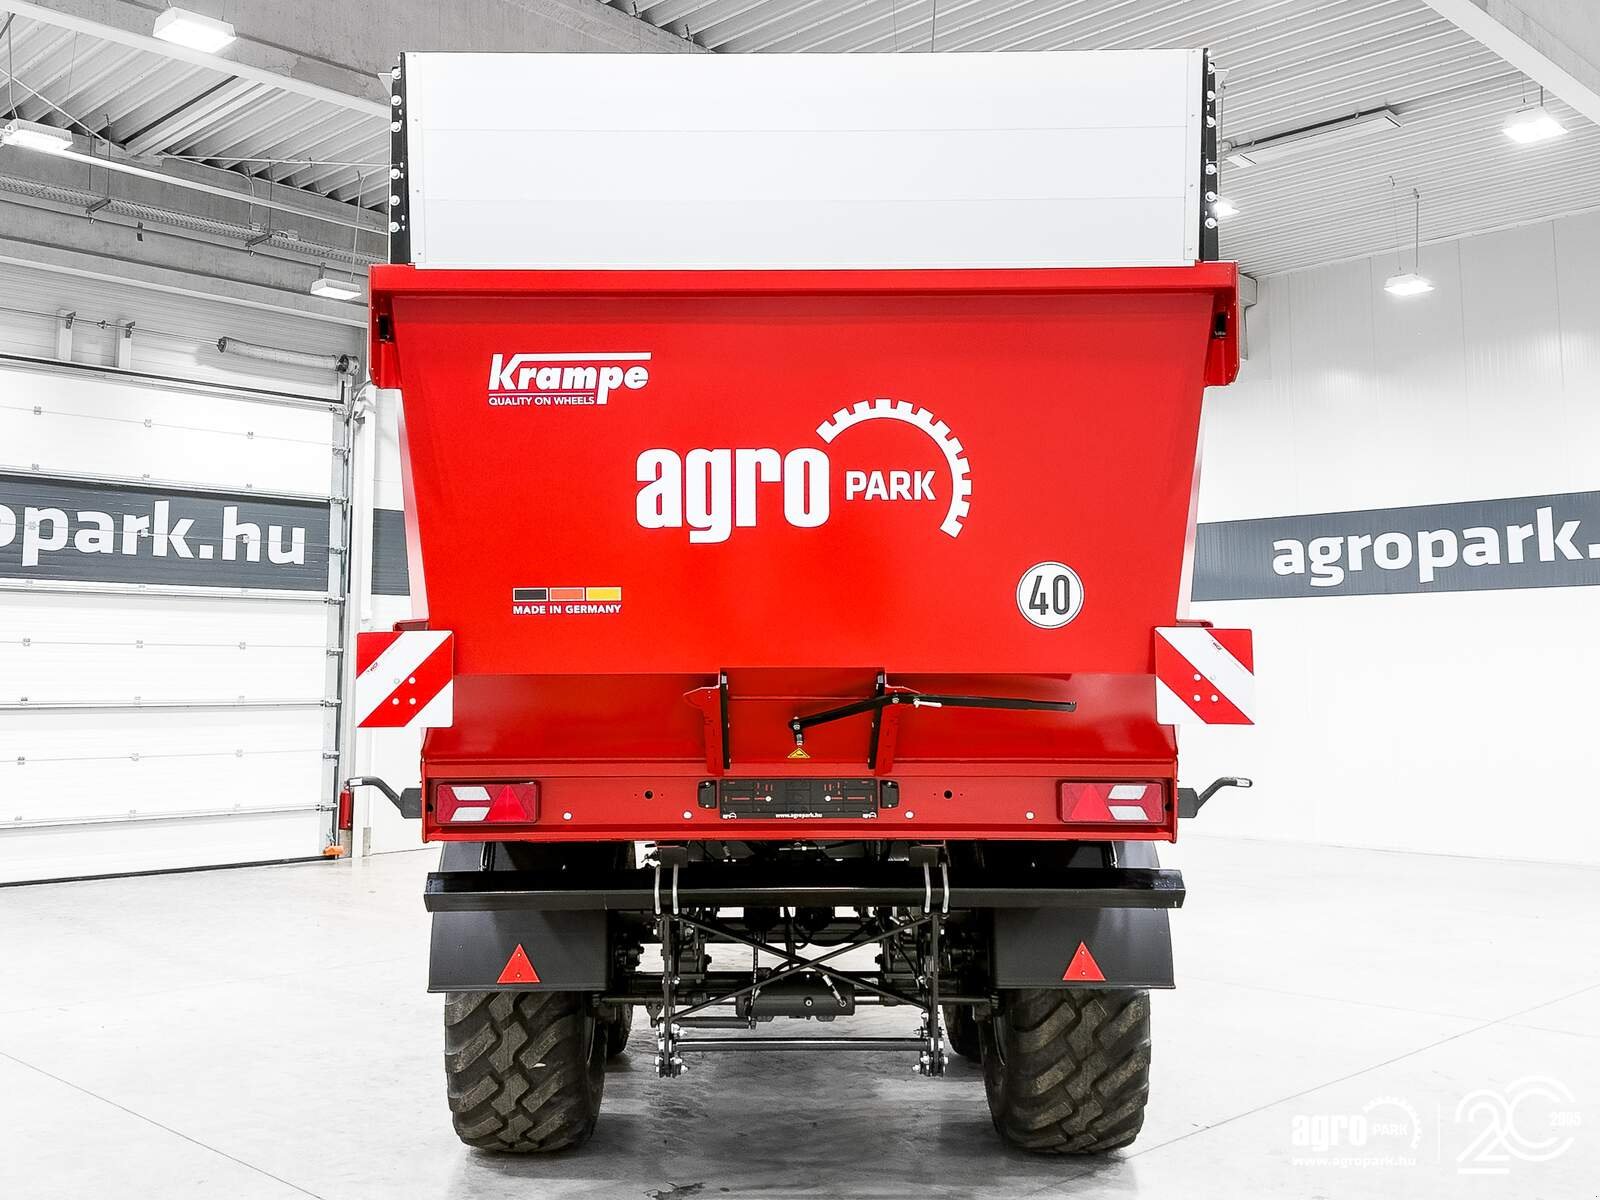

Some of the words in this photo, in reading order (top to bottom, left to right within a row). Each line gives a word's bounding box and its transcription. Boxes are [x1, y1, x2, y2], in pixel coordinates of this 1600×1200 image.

[488, 352, 651, 405] Krampe
[488, 396, 532, 406] QUALITY
[534, 396, 551, 406] ON
[553, 396, 595, 405] WHEELS
[636, 447, 830, 544] agro
[846, 470, 936, 501] PARK
[1272, 506, 1600, 588] agropark.
[512, 605, 546, 615] MADE
[549, 605, 562, 614] IN
[565, 604, 622, 614] GERMANY
[1028, 574, 1070, 616] 40
